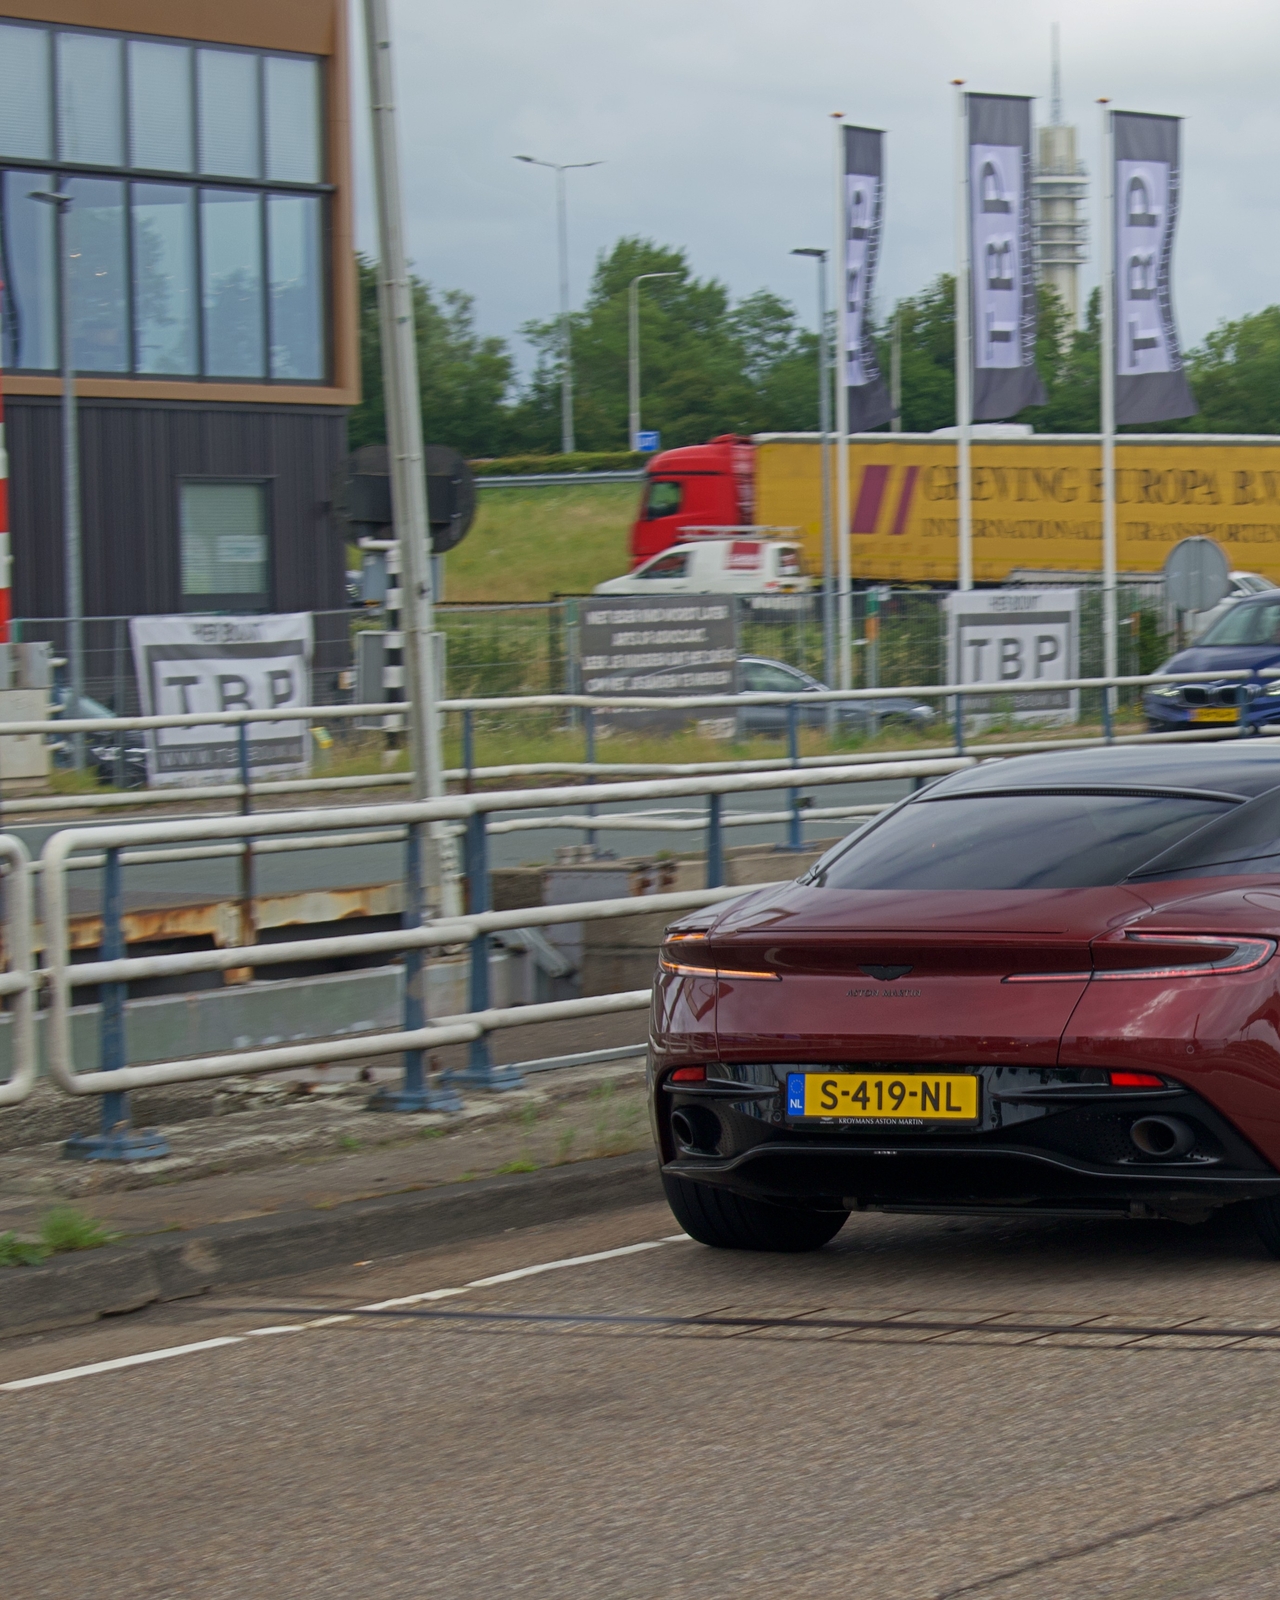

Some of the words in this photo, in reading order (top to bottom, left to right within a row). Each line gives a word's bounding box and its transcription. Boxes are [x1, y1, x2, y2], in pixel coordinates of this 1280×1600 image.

[981, 160, 1014, 360] TBP
[1126, 176, 1158, 368] TBP
[963, 635, 1060, 682] TBP
[164, 669, 294, 729] TBP
[790, 1099, 803, 1109] NL
[820, 1079, 962, 1112] S-419-NL
